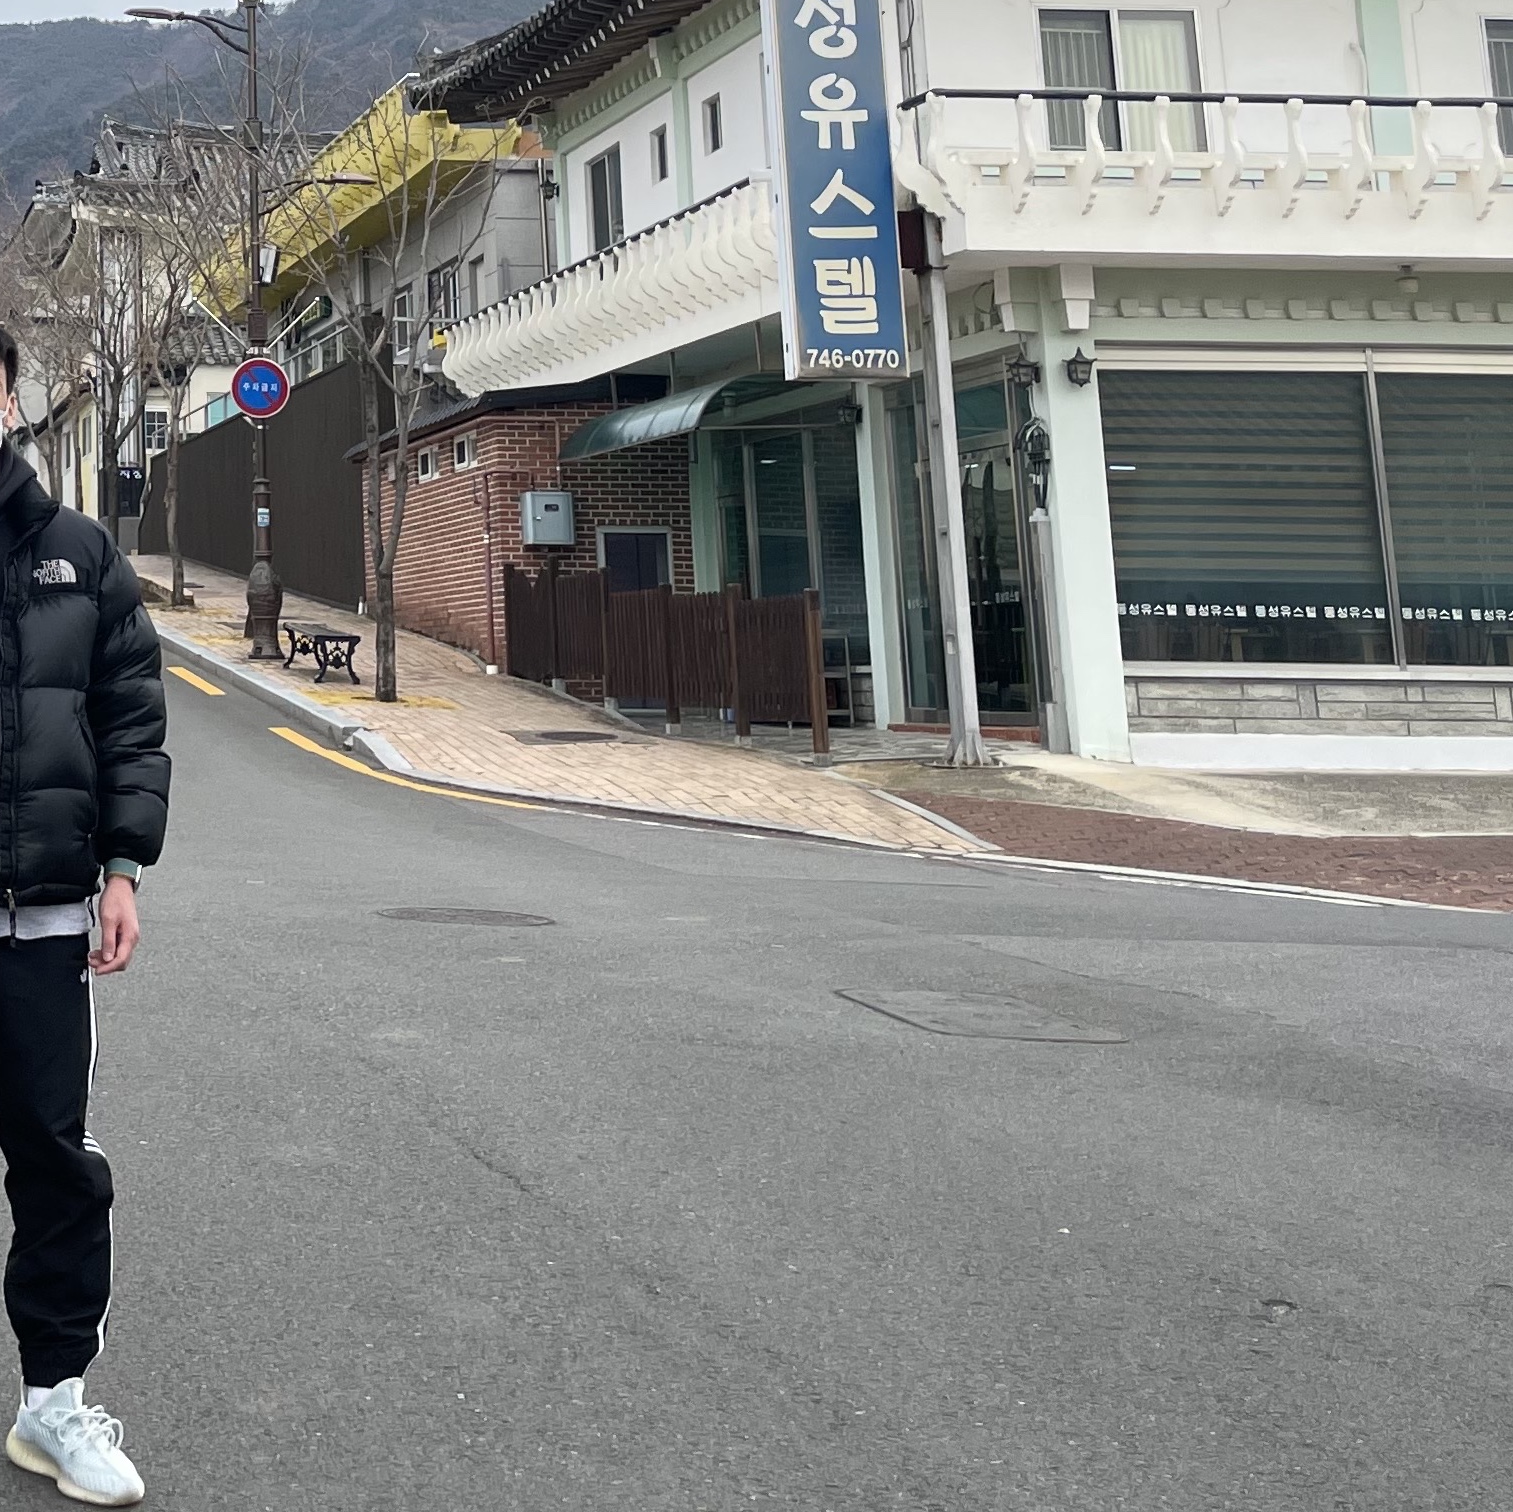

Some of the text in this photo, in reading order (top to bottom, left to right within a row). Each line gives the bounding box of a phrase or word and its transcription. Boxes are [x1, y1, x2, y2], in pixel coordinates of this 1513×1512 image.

[806, 348, 900, 369] 746-0770
[242, 382, 279, 392] 주차금지
[40, 559, 60, 569] THE
[39, 576, 63, 585] FACE
